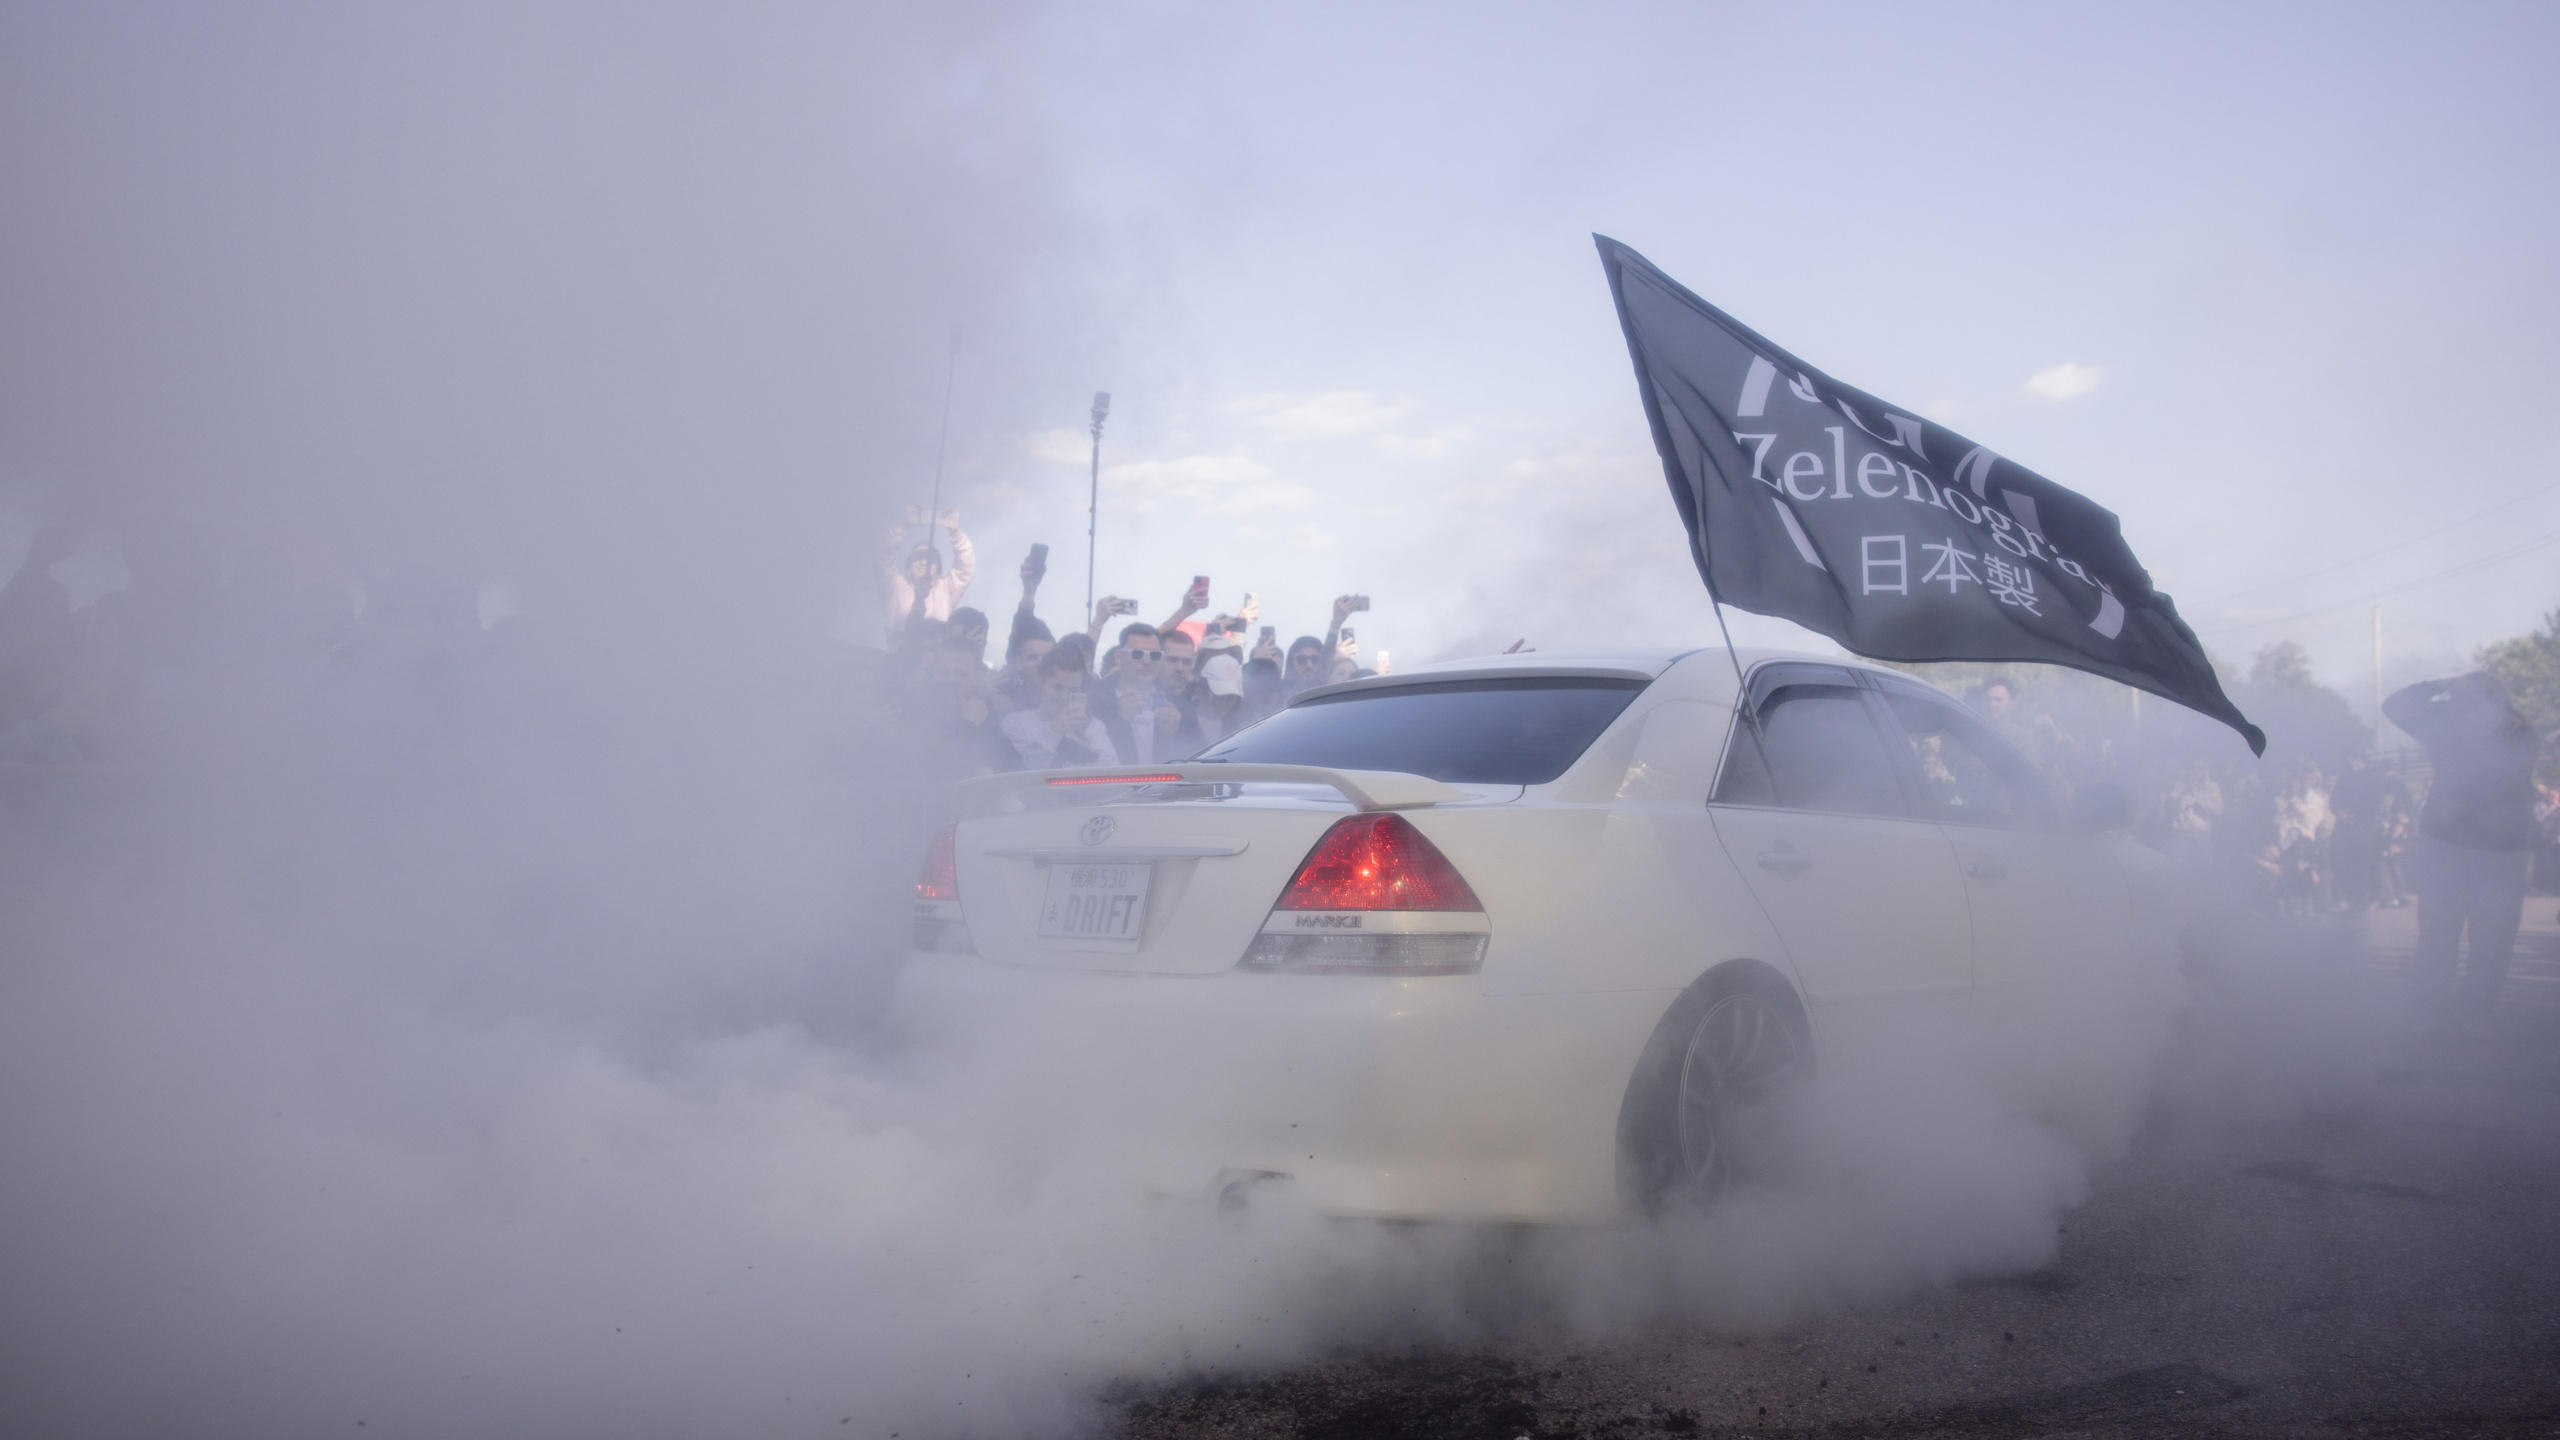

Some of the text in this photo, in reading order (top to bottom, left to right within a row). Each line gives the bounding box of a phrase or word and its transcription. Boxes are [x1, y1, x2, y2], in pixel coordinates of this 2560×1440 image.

[1861, 535, 2042, 617] 日本製
[1100, 868, 1128, 889] 530
[1063, 893, 1139, 935] DRIFT
